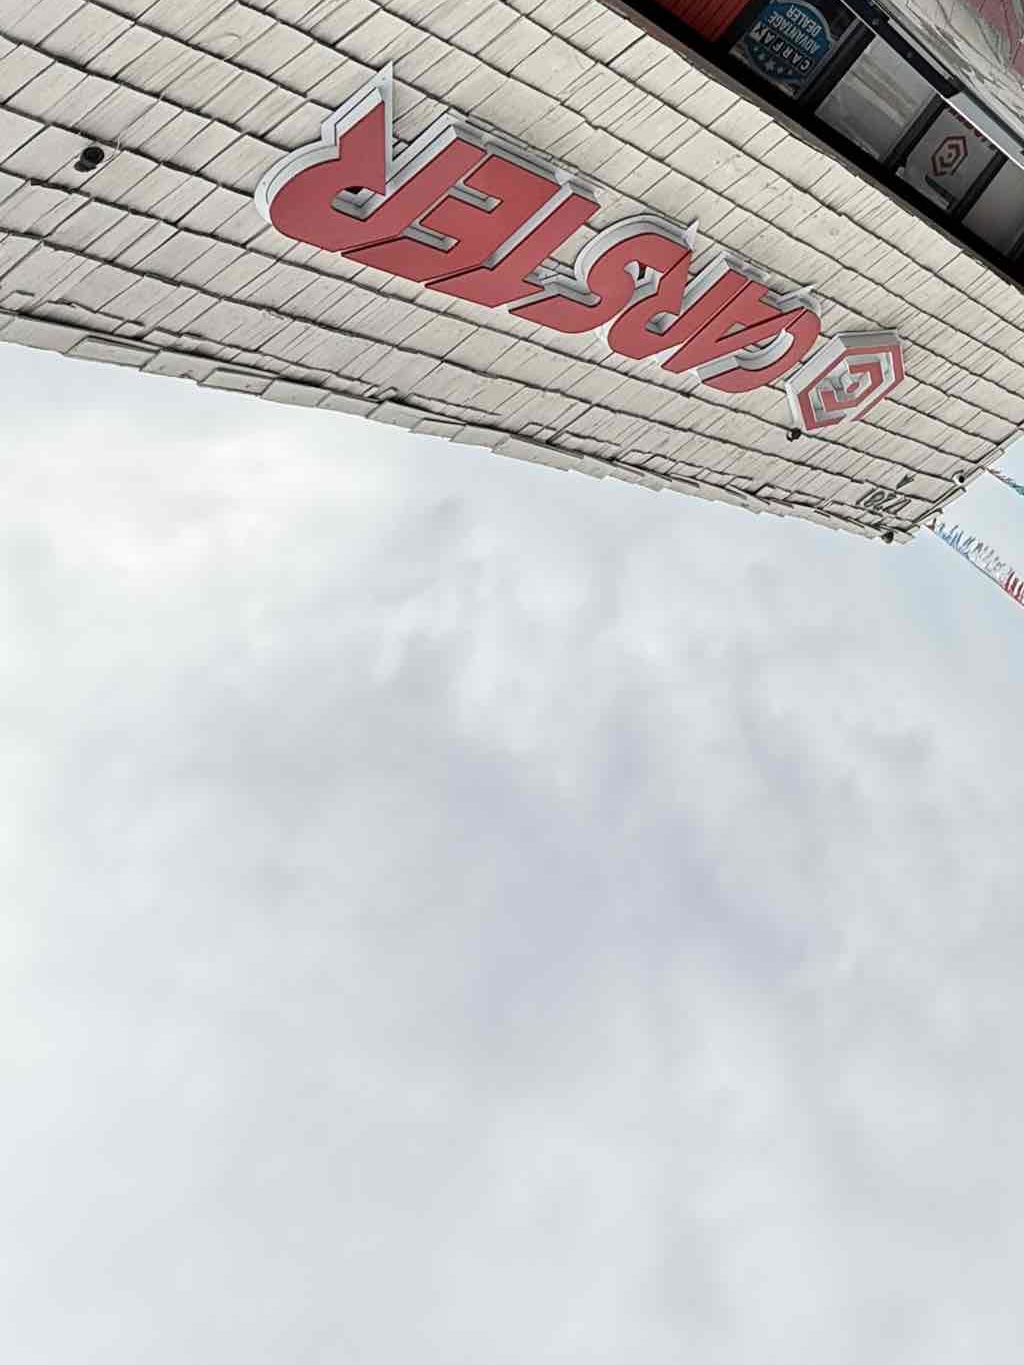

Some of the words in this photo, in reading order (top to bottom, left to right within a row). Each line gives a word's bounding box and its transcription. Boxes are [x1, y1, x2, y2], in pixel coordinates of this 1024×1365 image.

[766, 9, 820, 54] ADVANTAGE
[784, 3, 822, 36] DEALER
[749, 21, 812, 71] CARFAX
[255, 63, 822, 394] CARSTER
